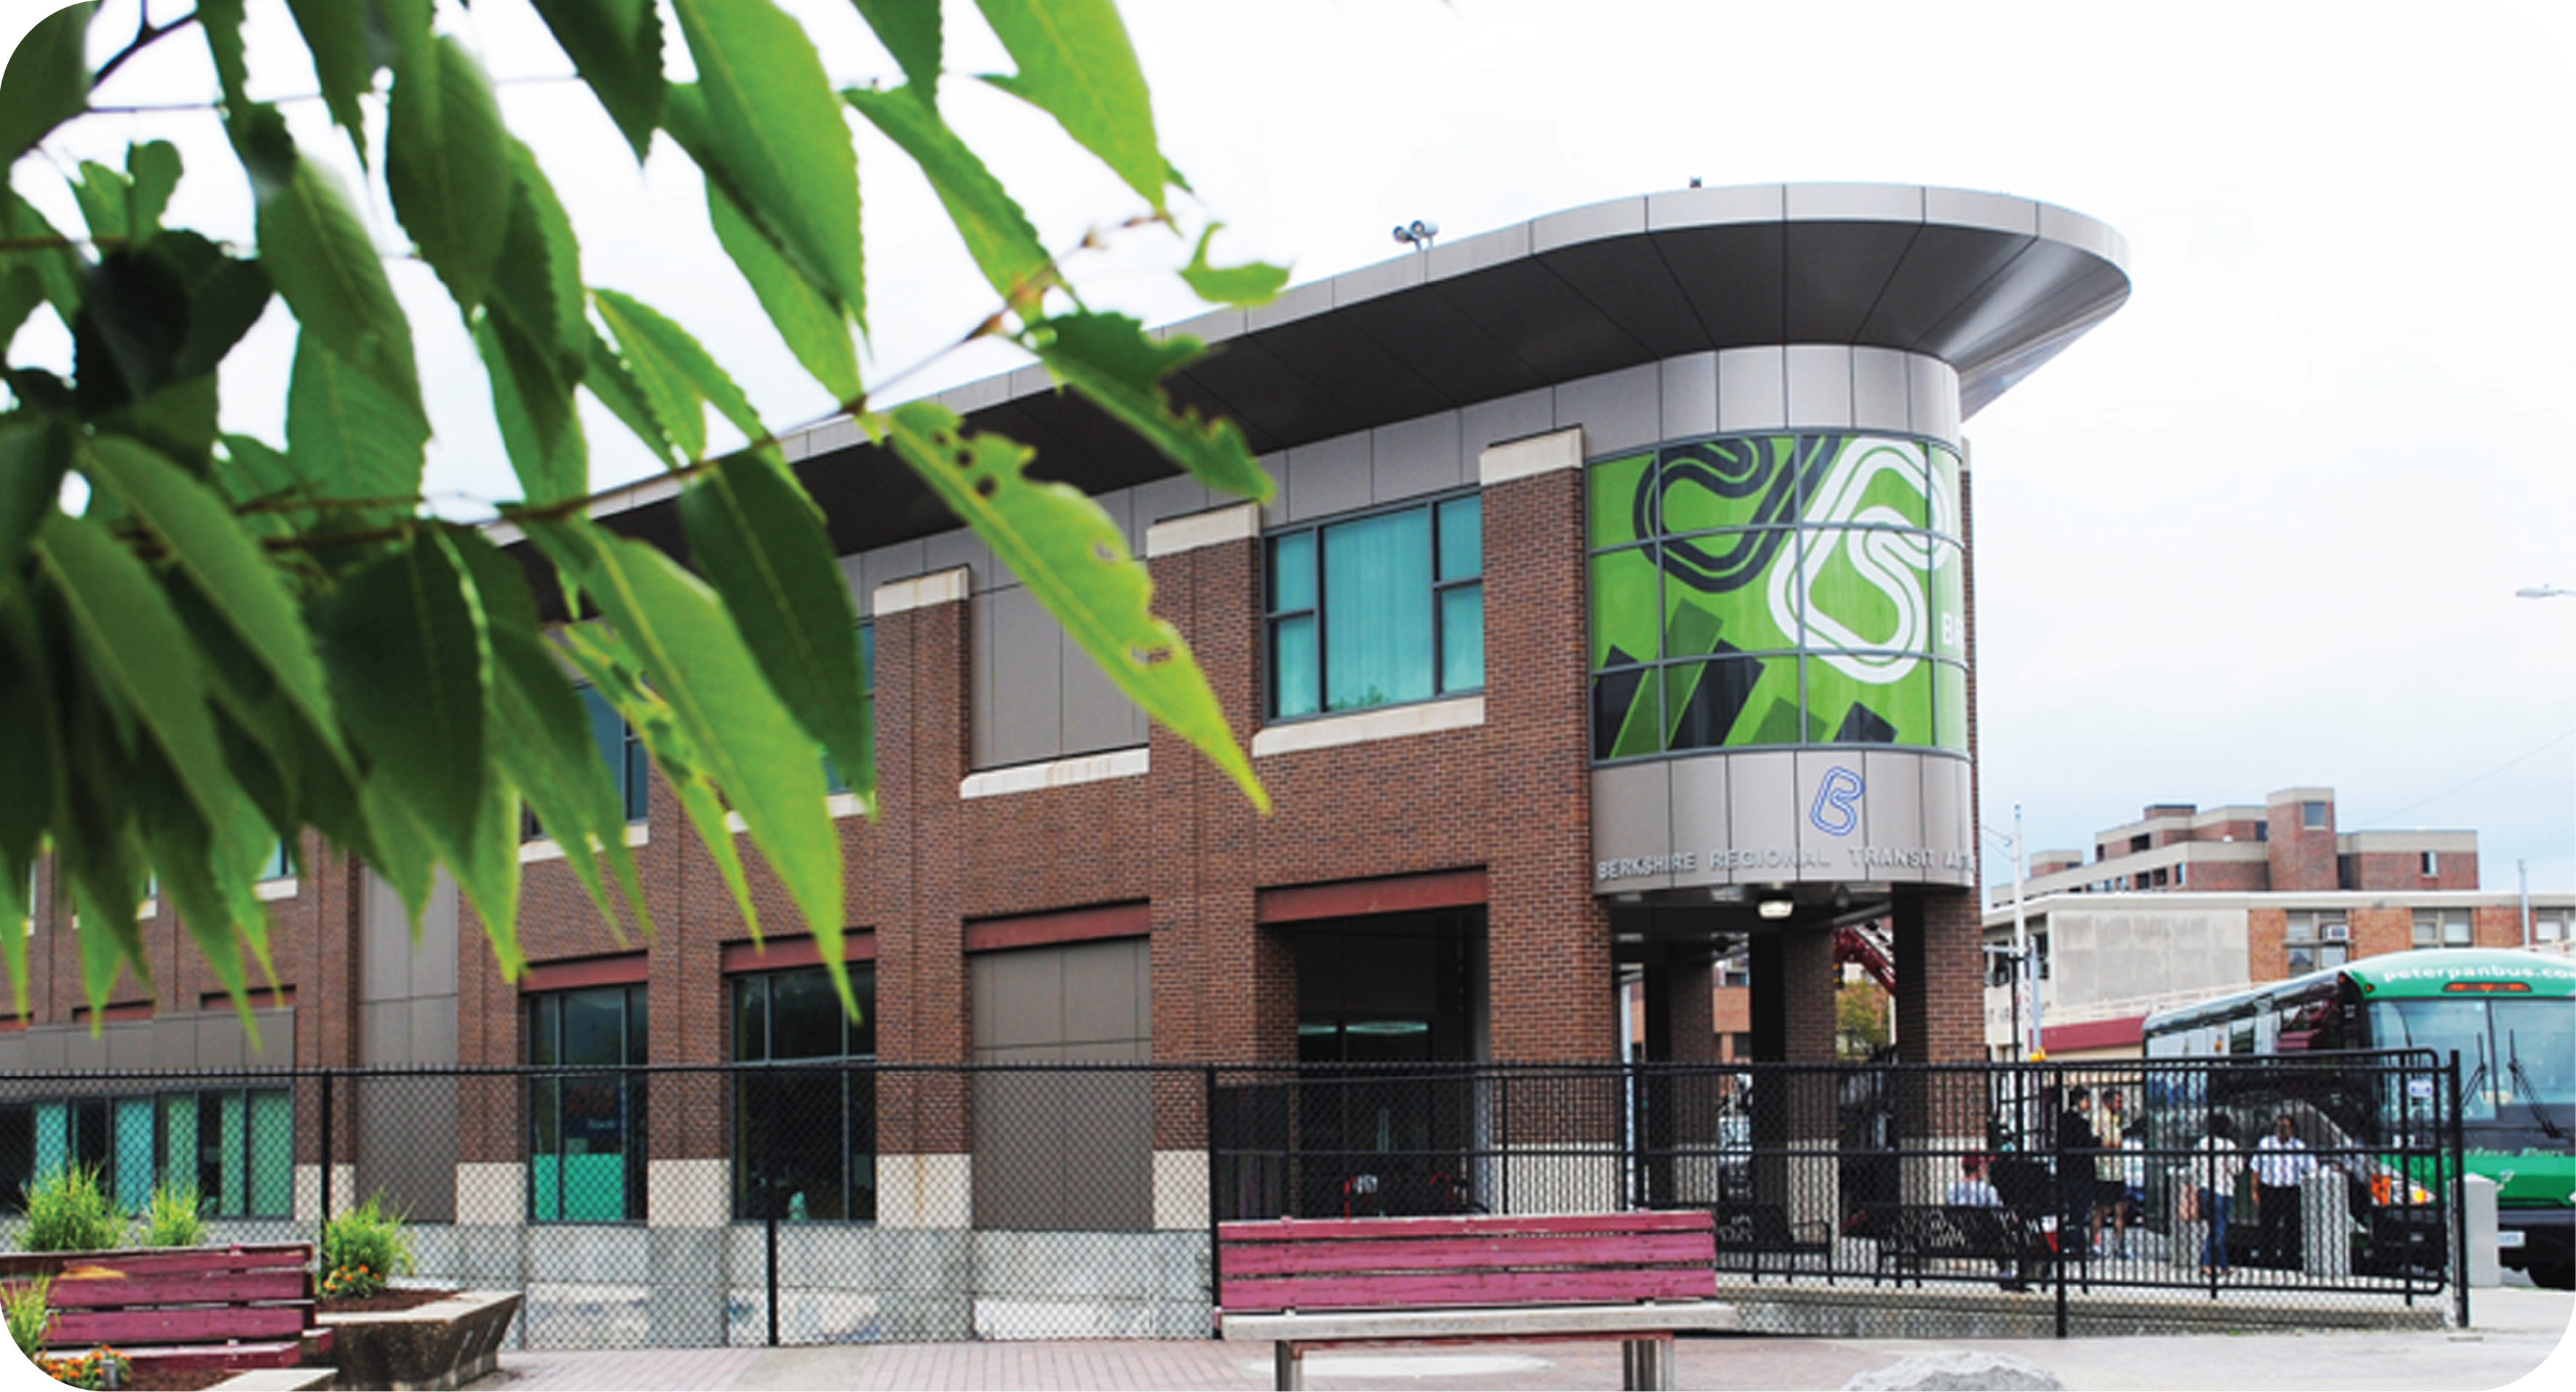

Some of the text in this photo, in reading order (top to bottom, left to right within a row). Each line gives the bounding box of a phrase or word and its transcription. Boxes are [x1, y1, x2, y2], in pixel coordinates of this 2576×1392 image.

[1598, 852, 1697, 881] BERKSHIRE
[1709, 847, 1831, 872] REGIONAL
[1848, 846, 1933, 869] TRANSIT
